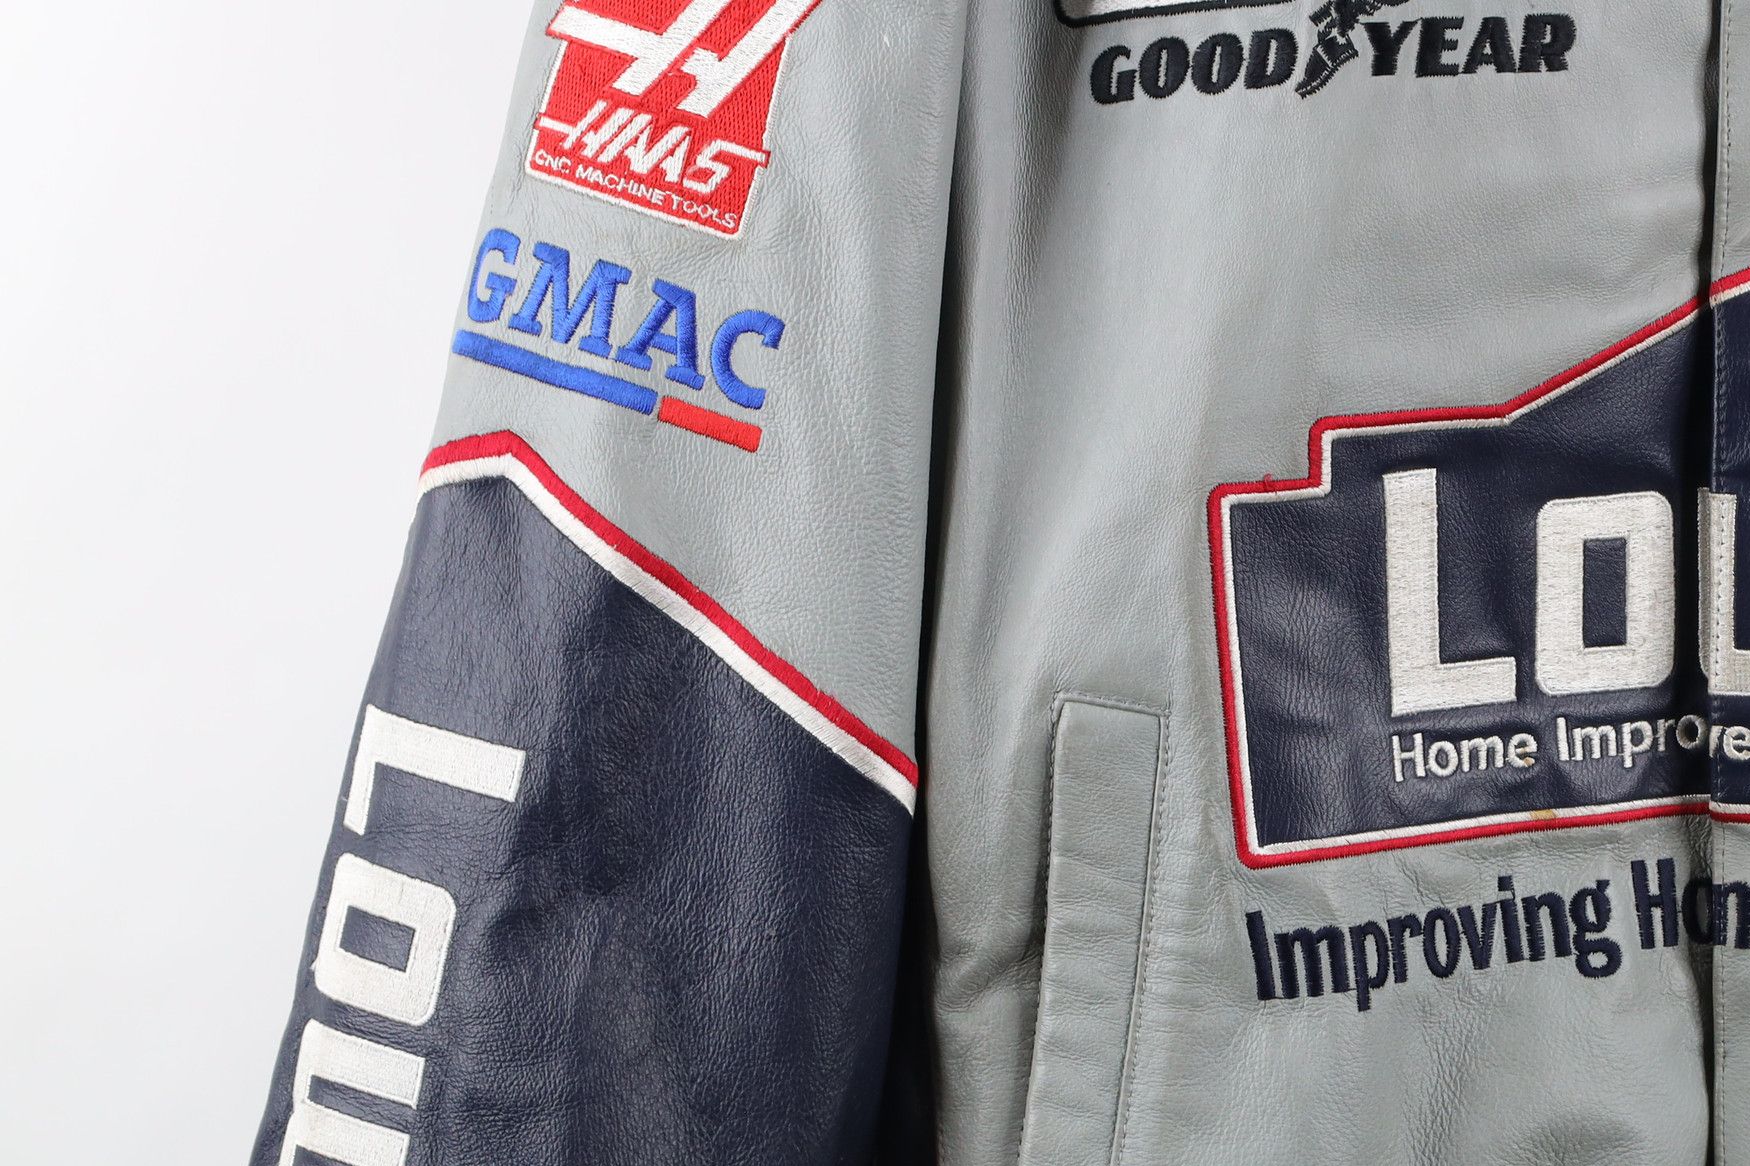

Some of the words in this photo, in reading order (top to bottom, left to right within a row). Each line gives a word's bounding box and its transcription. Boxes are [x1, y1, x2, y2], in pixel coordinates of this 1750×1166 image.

[536, 150, 572, 174] CNC
[576, 165, 664, 204] MACHINE
[671, 190, 737, 228] TOOLS
[538, 99, 766, 193] HAAS
[466, 228, 786, 410] GMAC
[1391, 727, 1539, 783] Home
[1245, 874, 1623, 1013] Improving
